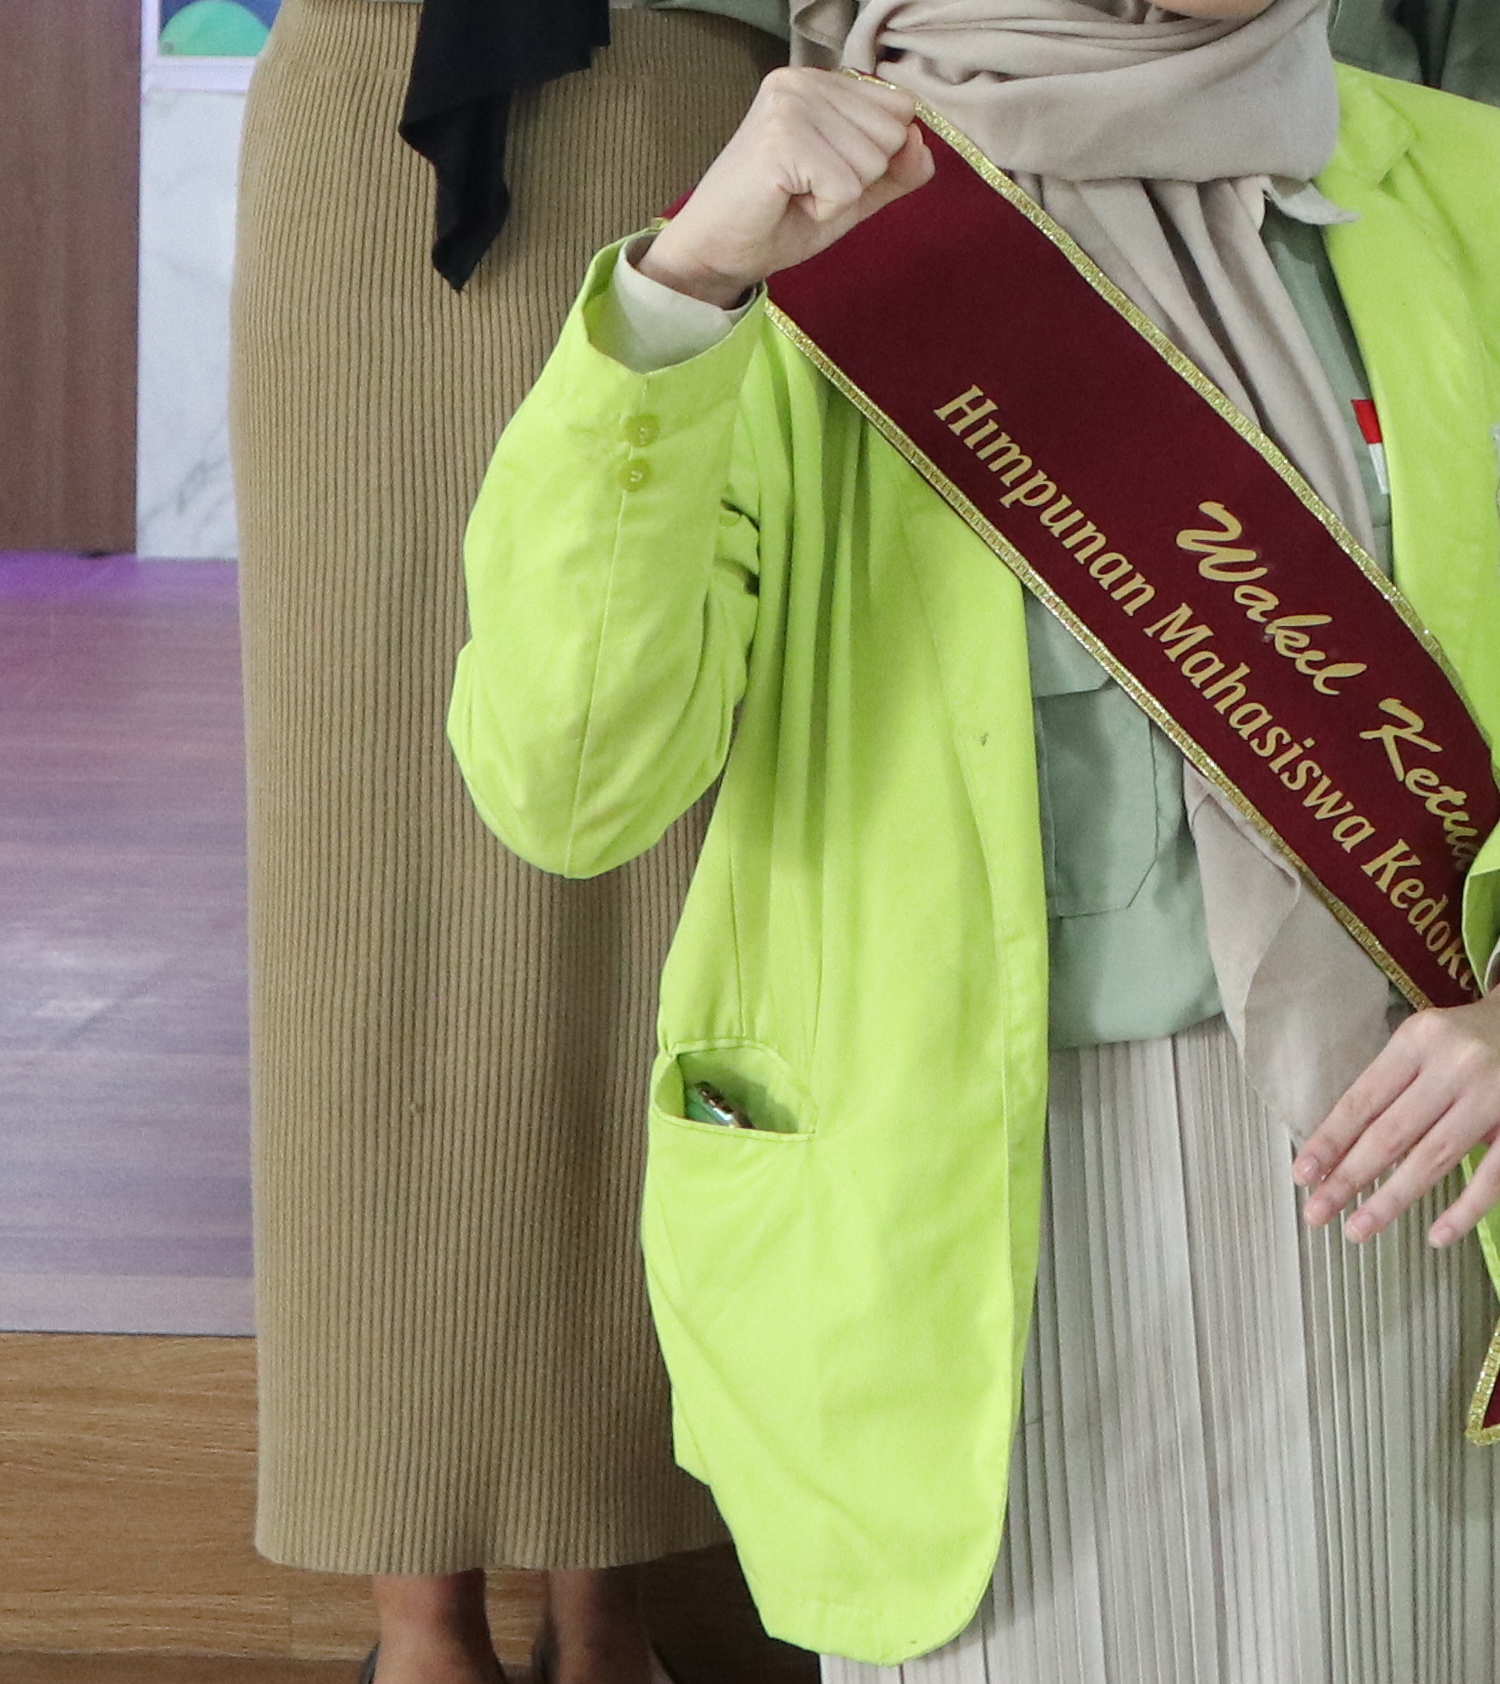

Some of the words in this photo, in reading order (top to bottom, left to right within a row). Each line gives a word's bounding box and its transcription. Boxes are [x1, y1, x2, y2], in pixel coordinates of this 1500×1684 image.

[933, 384, 1157, 617] Himpunan
[1143, 603, 1374, 853] Mahasiswa
[1176, 500, 1367, 696] Wakil
